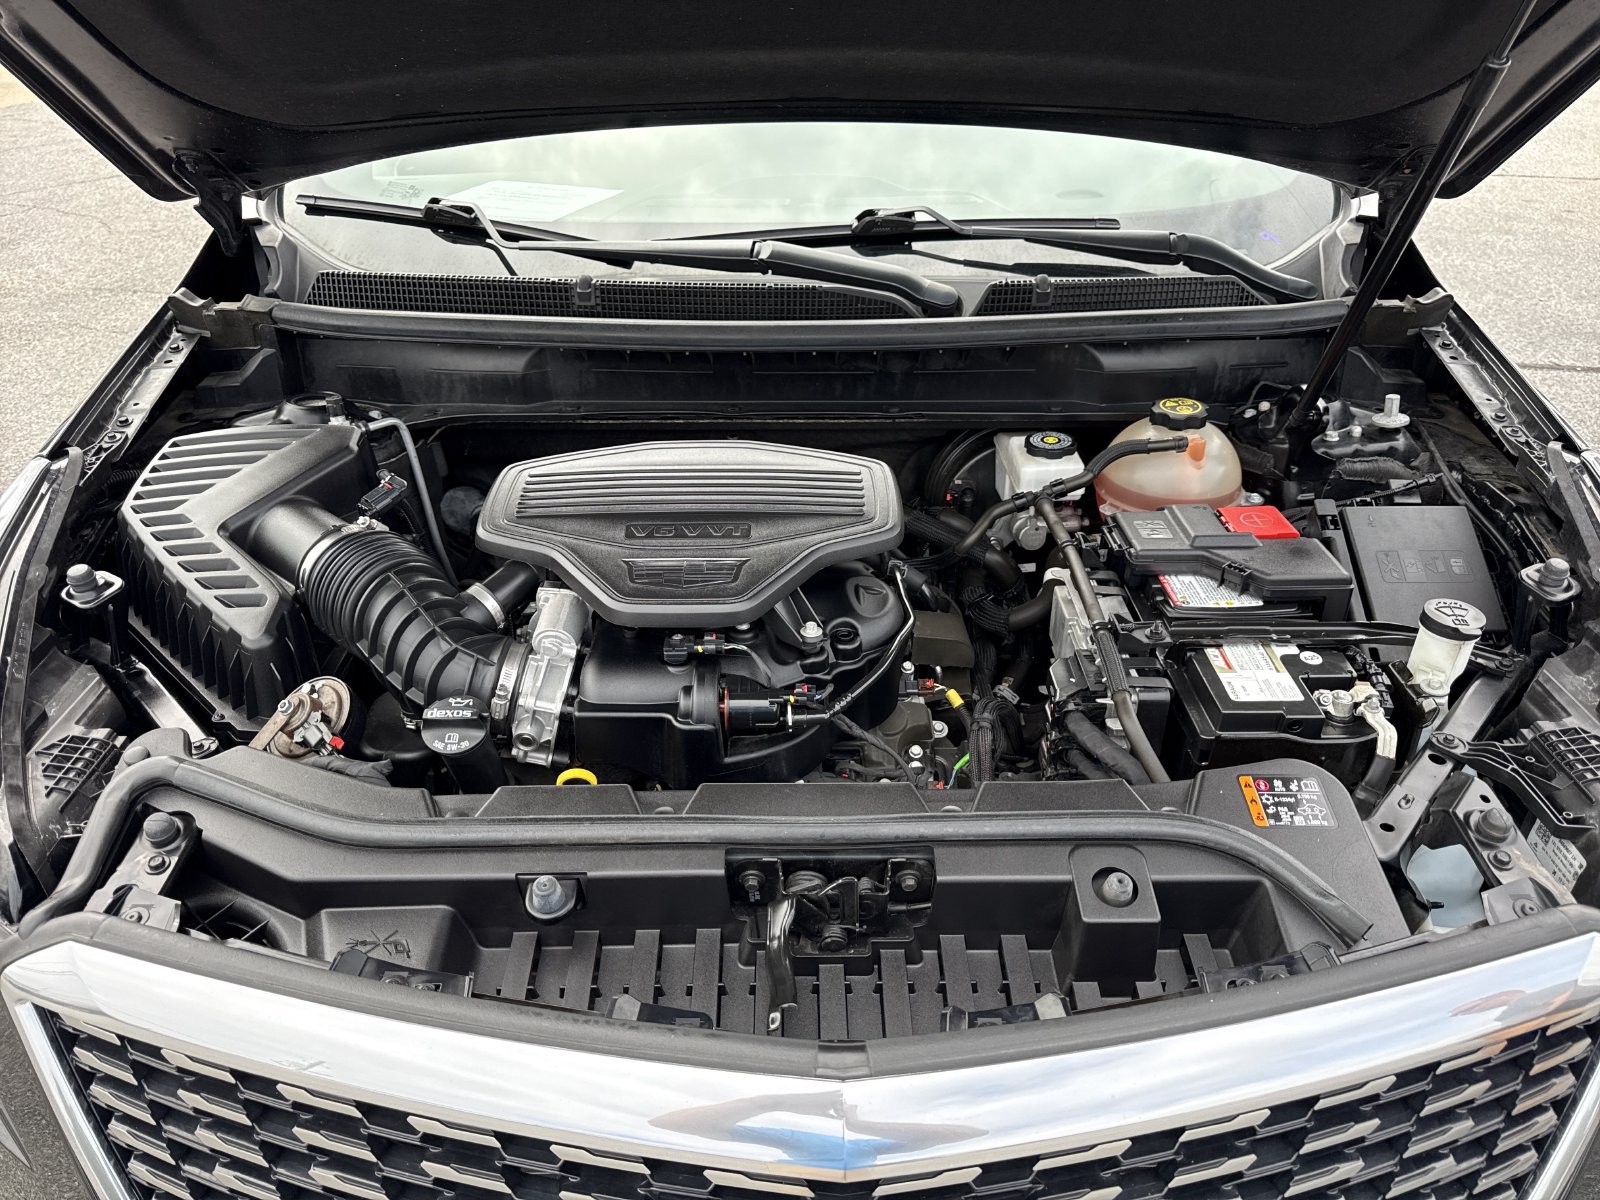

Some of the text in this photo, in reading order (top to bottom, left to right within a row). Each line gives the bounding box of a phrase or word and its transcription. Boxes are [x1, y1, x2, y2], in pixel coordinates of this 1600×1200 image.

[630, 525, 748, 537] V6 VVT
[427, 708, 473, 718] dexos
[433, 740, 469, 751] SAE 5W-30
